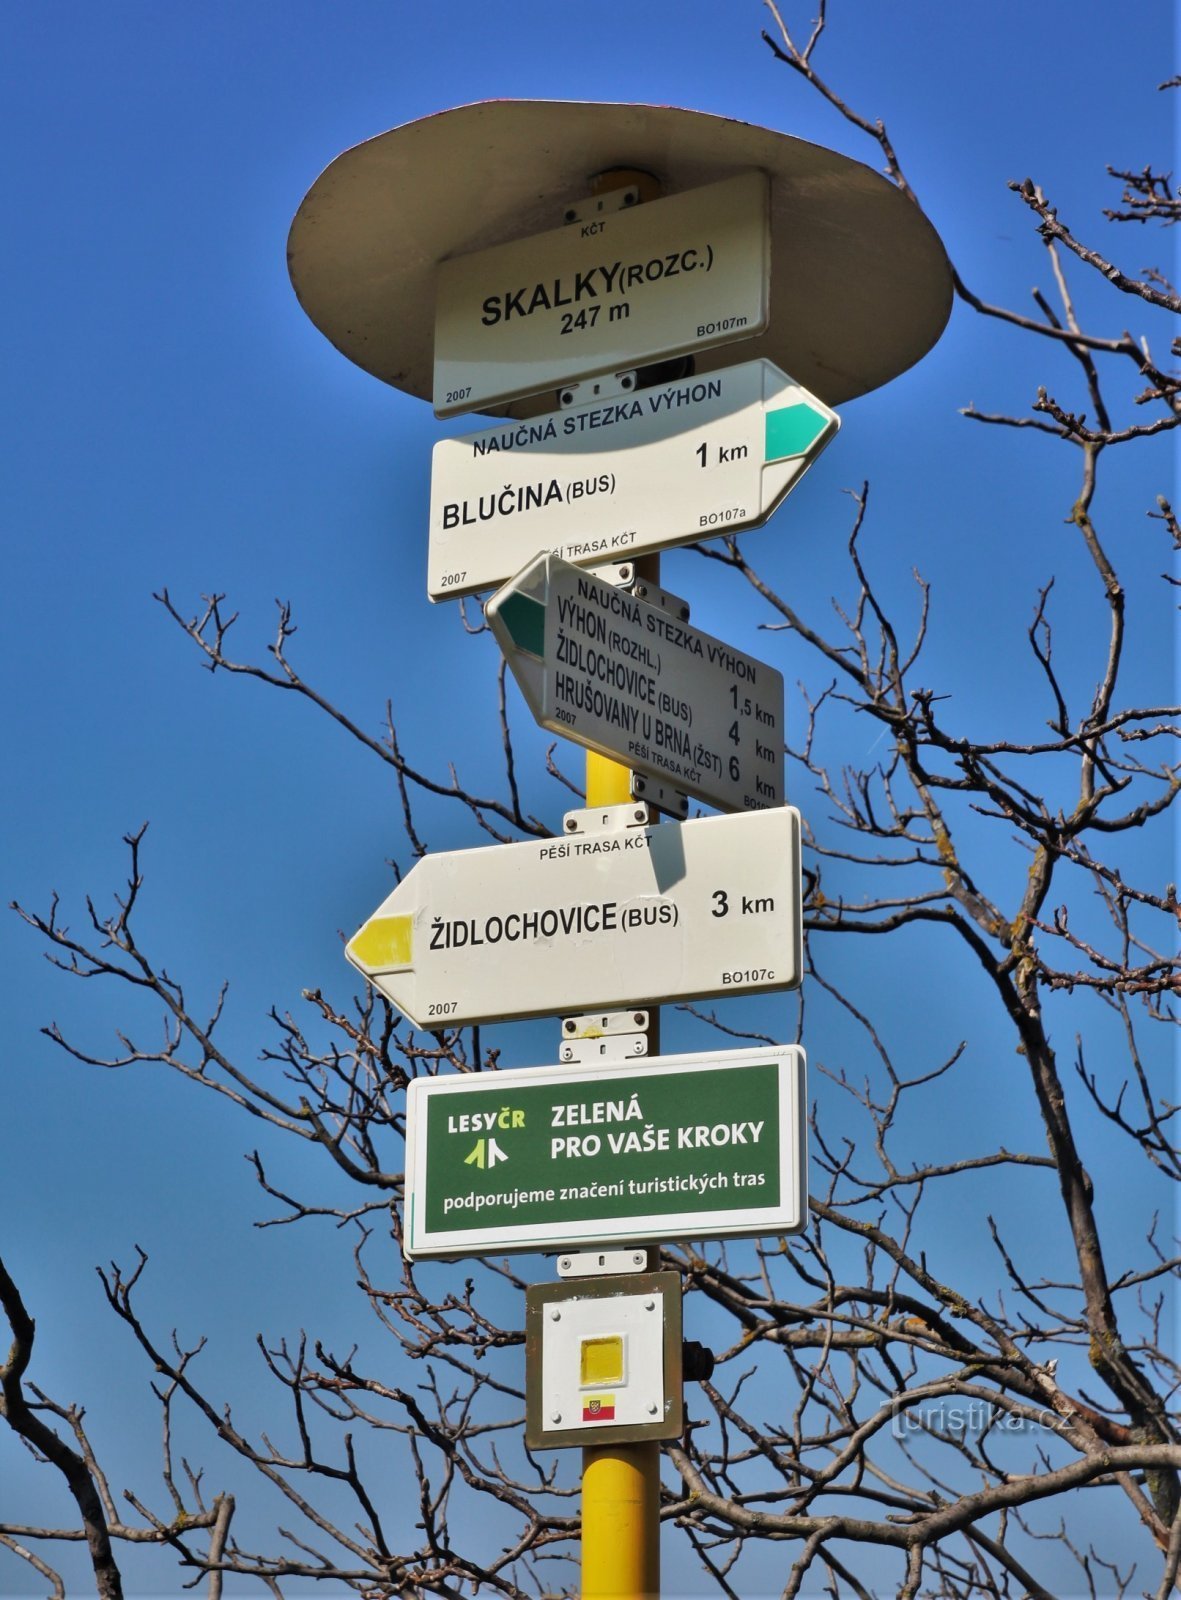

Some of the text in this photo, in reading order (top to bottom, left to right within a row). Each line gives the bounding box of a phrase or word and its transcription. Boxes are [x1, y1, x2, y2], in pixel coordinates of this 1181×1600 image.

[580, 221, 606, 238] KČT
[560, 302, 630, 335] 247 m
[696, 315, 748, 337] BO107m
[445, 387, 472, 403] 2007
[472, 379, 722, 458] NAUČNÁ STEZKA VÝHON
[695, 443, 708, 468] 1
[718, 443, 749, 464] km
[699, 508, 747, 527] BO107a
[566, 538, 609, 557] TRASA
[611, 531, 637, 548] KČT
[440, 571, 467, 587] 2007
[577, 578, 757, 686] NAUČNÁ STEZKA VÝHON
[557, 595, 606, 645] VÝHON
[755, 703, 776, 728] km
[556, 628, 656, 706] ŽIDLOCHOVICE
[728, 720, 741, 747] 4
[755, 739, 776, 764] km
[555, 707, 577, 726] 2007
[555, 671, 640, 734] HRUŠOVANY
[642, 712, 652, 741] U
[655, 719, 692, 761] BRNA
[728, 755, 741, 783] 6
[755, 775, 776, 800] km
[651, 751, 682, 775] TRASA
[683, 767, 702, 784] KČT
[539, 834, 653, 861] PĚŠÍ TRASA KČT
[429, 901, 618, 951] ŽIDLOCHOVICE
[711, 889, 729, 918] 3
[741, 894, 775, 916] km
[721, 968, 775, 985] BO107c
[428, 1001, 458, 1016] 2007
[550, 1092, 643, 1128] ZELENÁ
[550, 1120, 765, 1160] PRO VAŠE KROKY
[443, 1171, 766, 1214] podporujeme značení turistických tras
